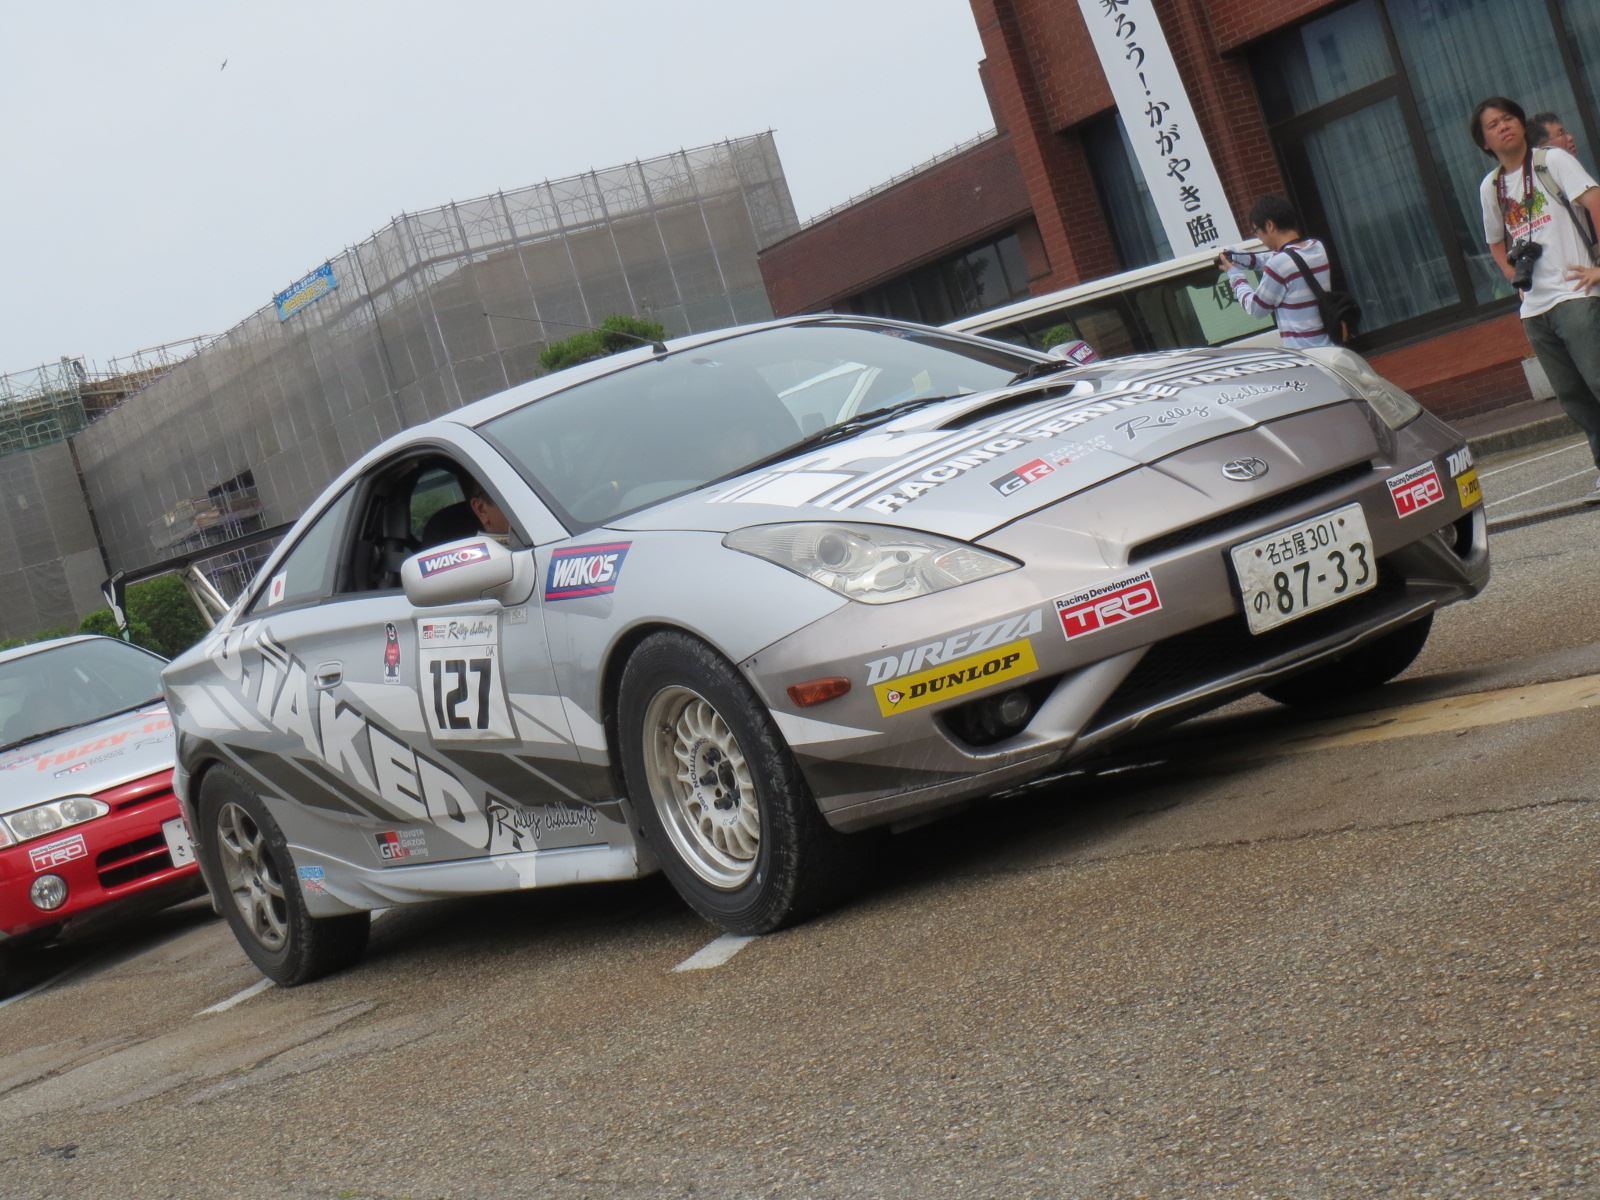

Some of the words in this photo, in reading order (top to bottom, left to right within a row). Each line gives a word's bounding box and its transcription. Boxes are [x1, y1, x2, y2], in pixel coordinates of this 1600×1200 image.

[1114, 405, 1209, 440] Rally
[865, 438, 1026, 515] RACING
[1000, 461, 1054, 497] GR
[1388, 477, 1407, 488] Racing
[1405, 464, 1435, 482] Development
[1395, 478, 1439, 510] TRD
[552, 553, 619, 588] WAKO'S
[1273, 542, 1370, 615] 87-33
[1056, 592, 1090, 609] Racing
[1089, 571, 1150, 598] Development
[1065, 588, 1153, 629] TRD
[865, 608, 1043, 687] DIREZZA
[429, 658, 492, 730] 127
[909, 652, 1021, 700] DUNLOP
[488, 800, 543, 840] Rally
[35, 844, 82, 866] TRD
[380, 843, 403, 859] GR
